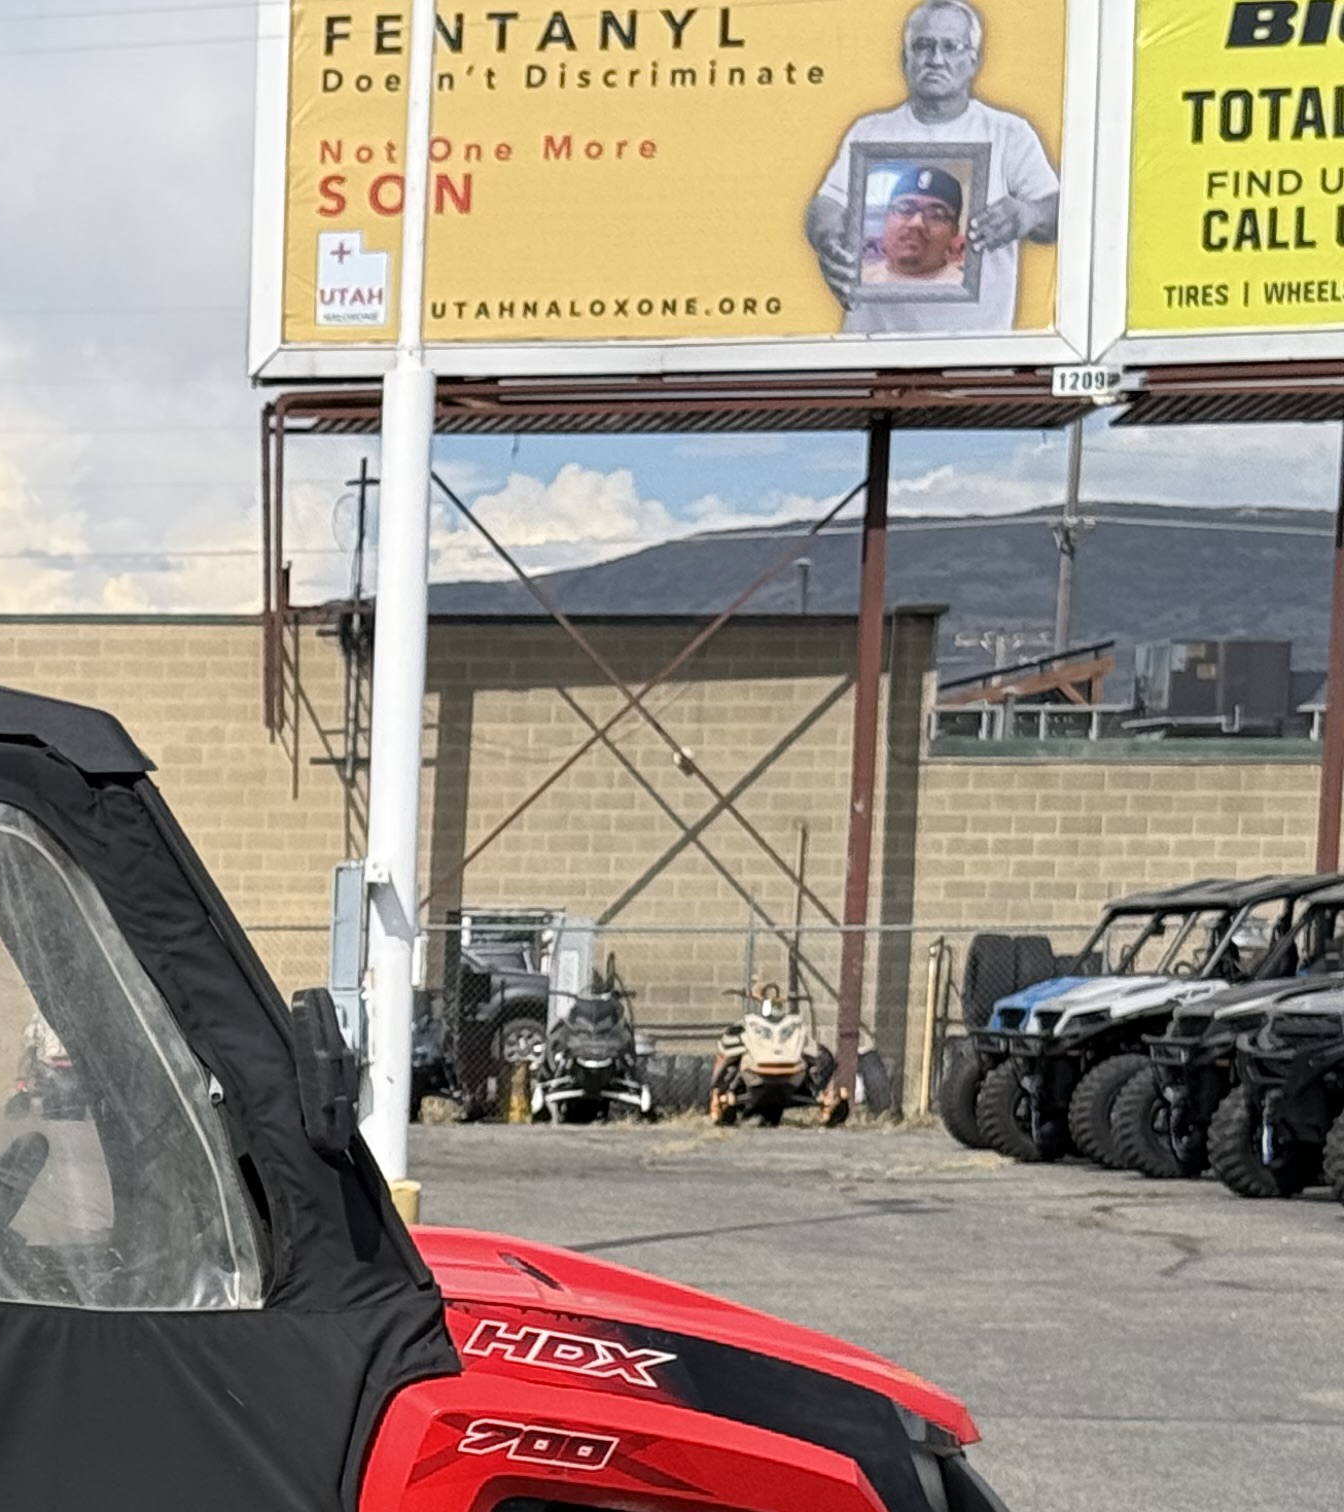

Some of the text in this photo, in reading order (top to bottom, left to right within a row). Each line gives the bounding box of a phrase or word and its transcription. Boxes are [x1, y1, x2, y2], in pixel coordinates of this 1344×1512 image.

[324, 8, 745, 55] FENTANYL
[1224, 0, 1344, 49] BI
[322, 59, 824, 93] Doen't Discriminate
[320, 134, 657, 164] Not One More
[317, 173, 472, 216] SON
[1207, 169, 1303, 199] FIND
[1202, 206, 1317, 253] CALL
[319, 287, 383, 306] UTAH
[431, 297, 782, 320] UTAHNALOXONE.ORG
[1163, 283, 1229, 309] TIRES
[1264, 279, 1344, 305] WHEEL
[1059, 371, 1105, 391] 1209
[462, 1319, 678, 1388] HDX
[458, 1418, 620, 1471] 700
